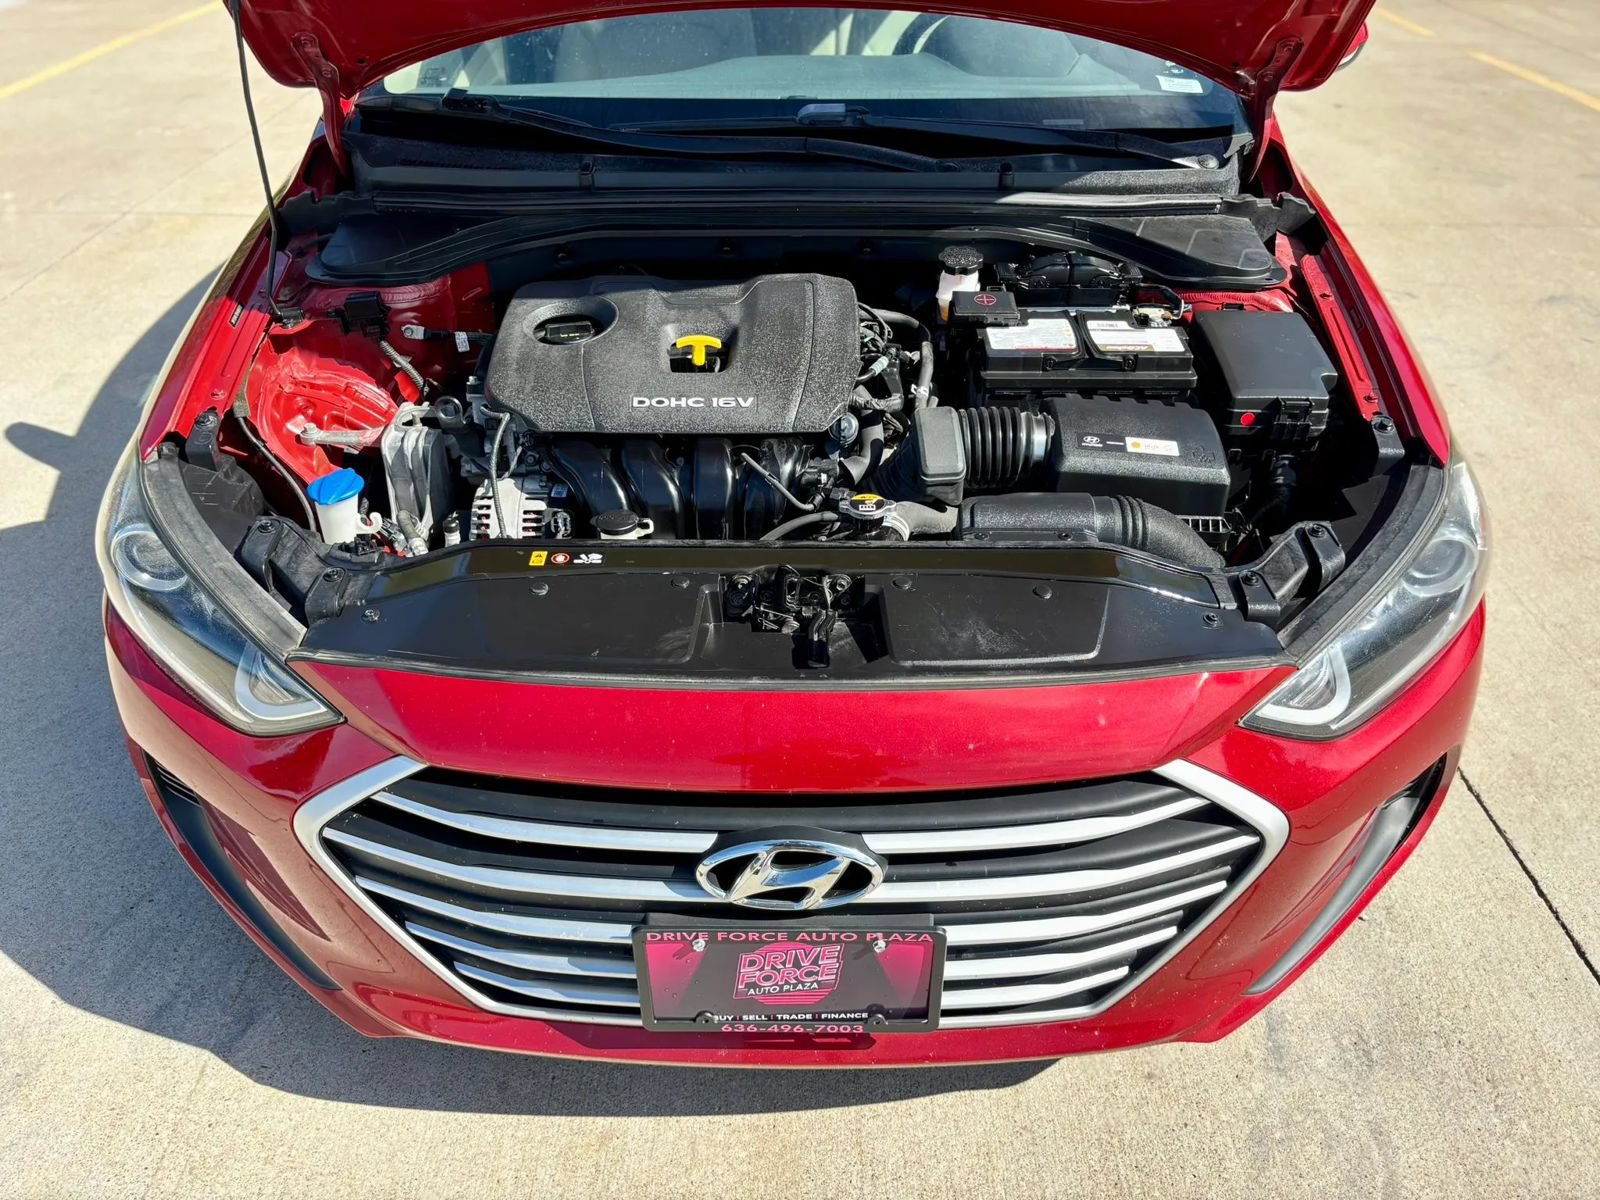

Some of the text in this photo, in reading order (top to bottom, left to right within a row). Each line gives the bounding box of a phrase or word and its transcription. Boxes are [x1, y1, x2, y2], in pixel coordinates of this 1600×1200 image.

[632, 397, 754, 408] DOHC 16V
[646, 932, 933, 942] DRIVE FORCE AUTO PLAZA
[740, 945, 841, 972] DRIVE
[738, 962, 840, 989] FORCE
[747, 982, 819, 996] AUTO PLAZA
[721, 1024, 864, 1033] 636-496-7003
